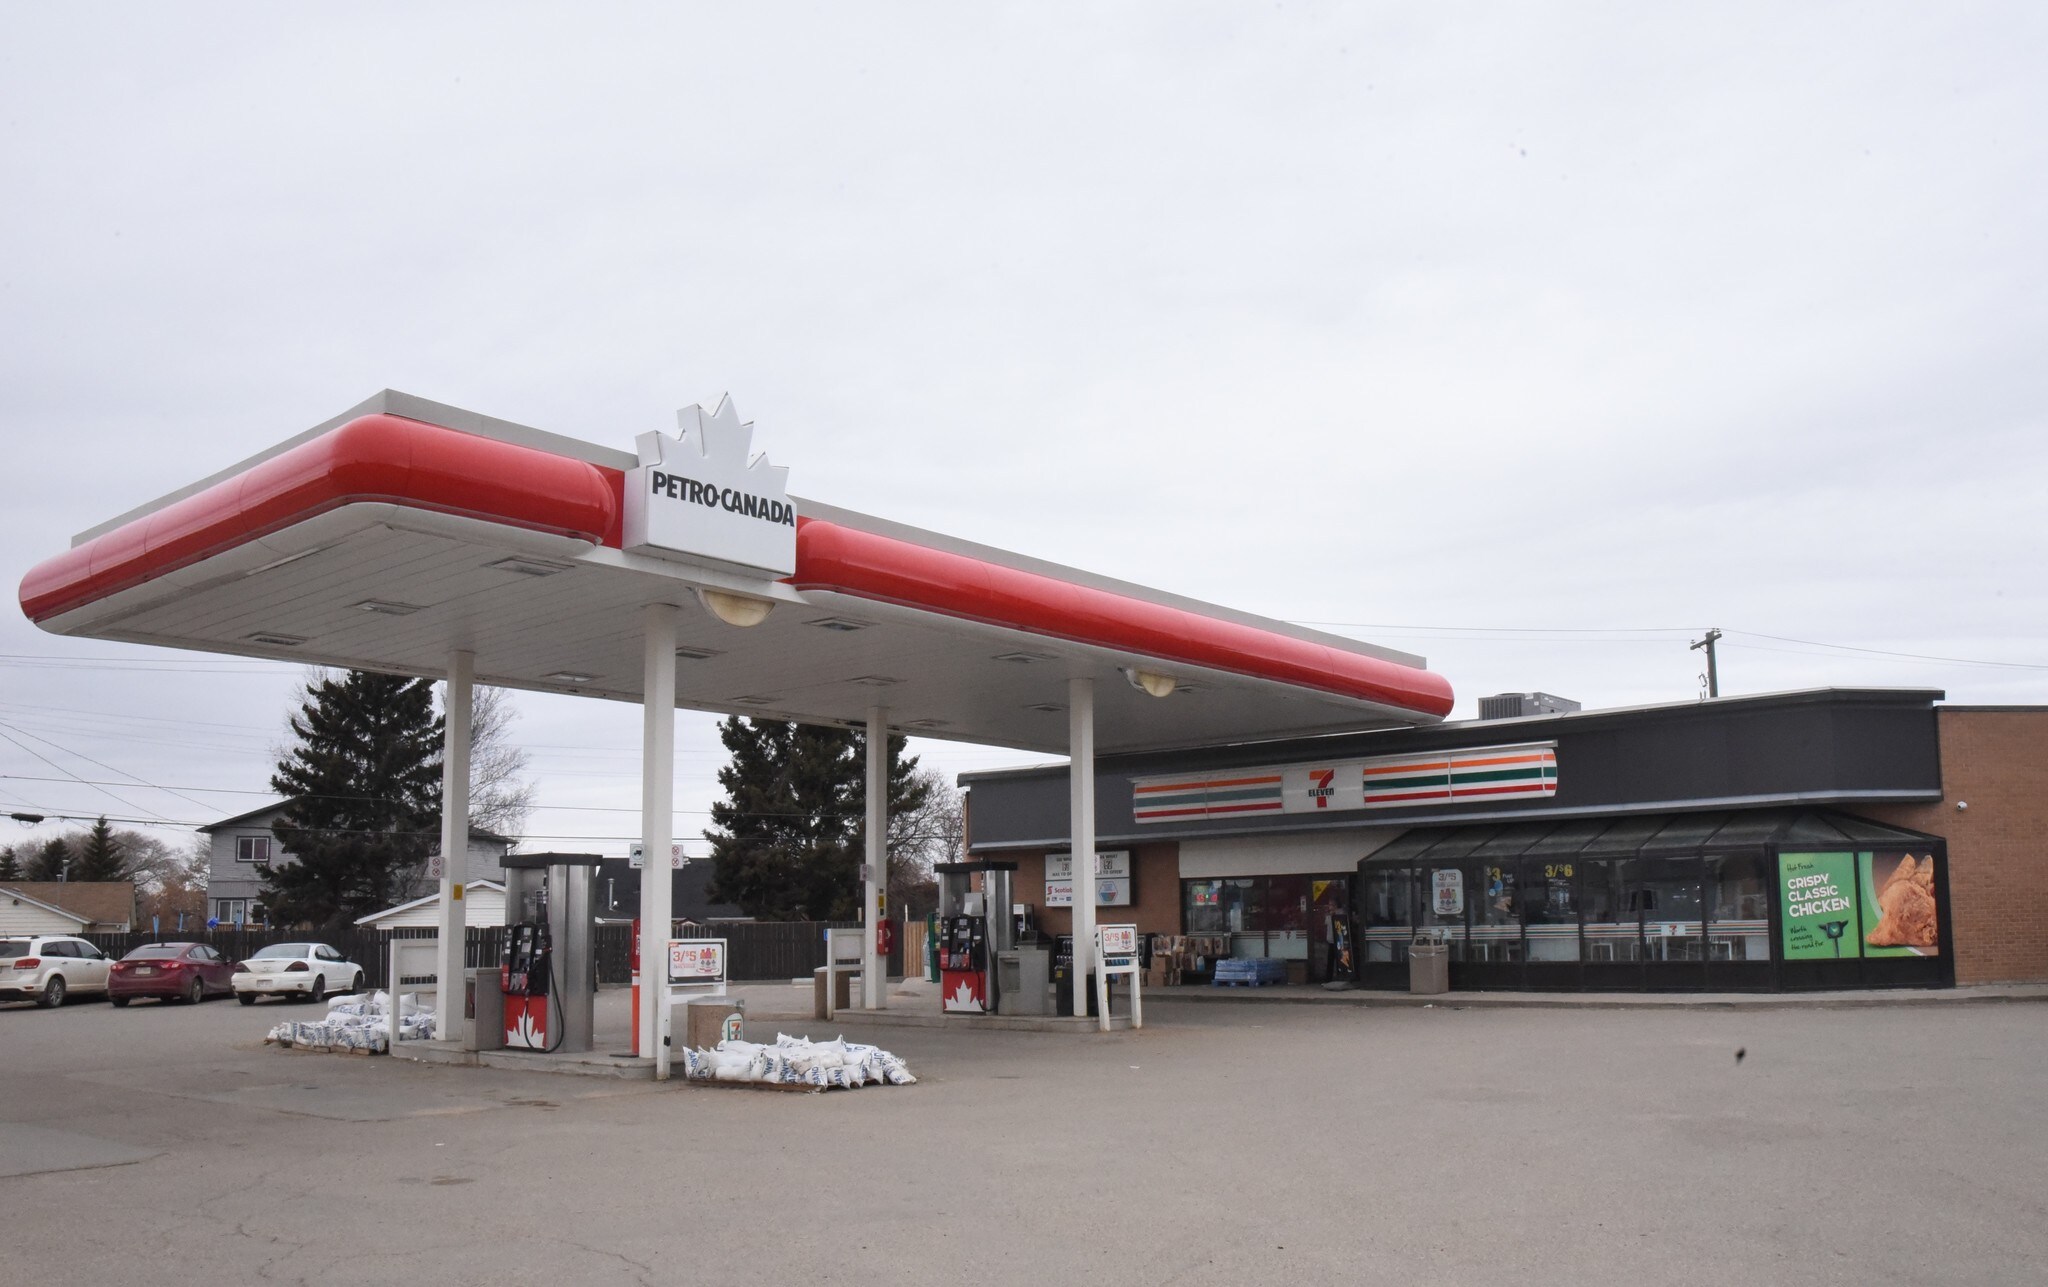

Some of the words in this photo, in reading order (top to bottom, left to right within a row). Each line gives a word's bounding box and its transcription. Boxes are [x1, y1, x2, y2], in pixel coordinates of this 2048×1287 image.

[1308, 768, 1335, 808] 7
[1787, 873, 1829, 889] CRISPY
[1788, 885, 1839, 902] CLASSIC
[1789, 896, 1851, 918] CHICKEN
